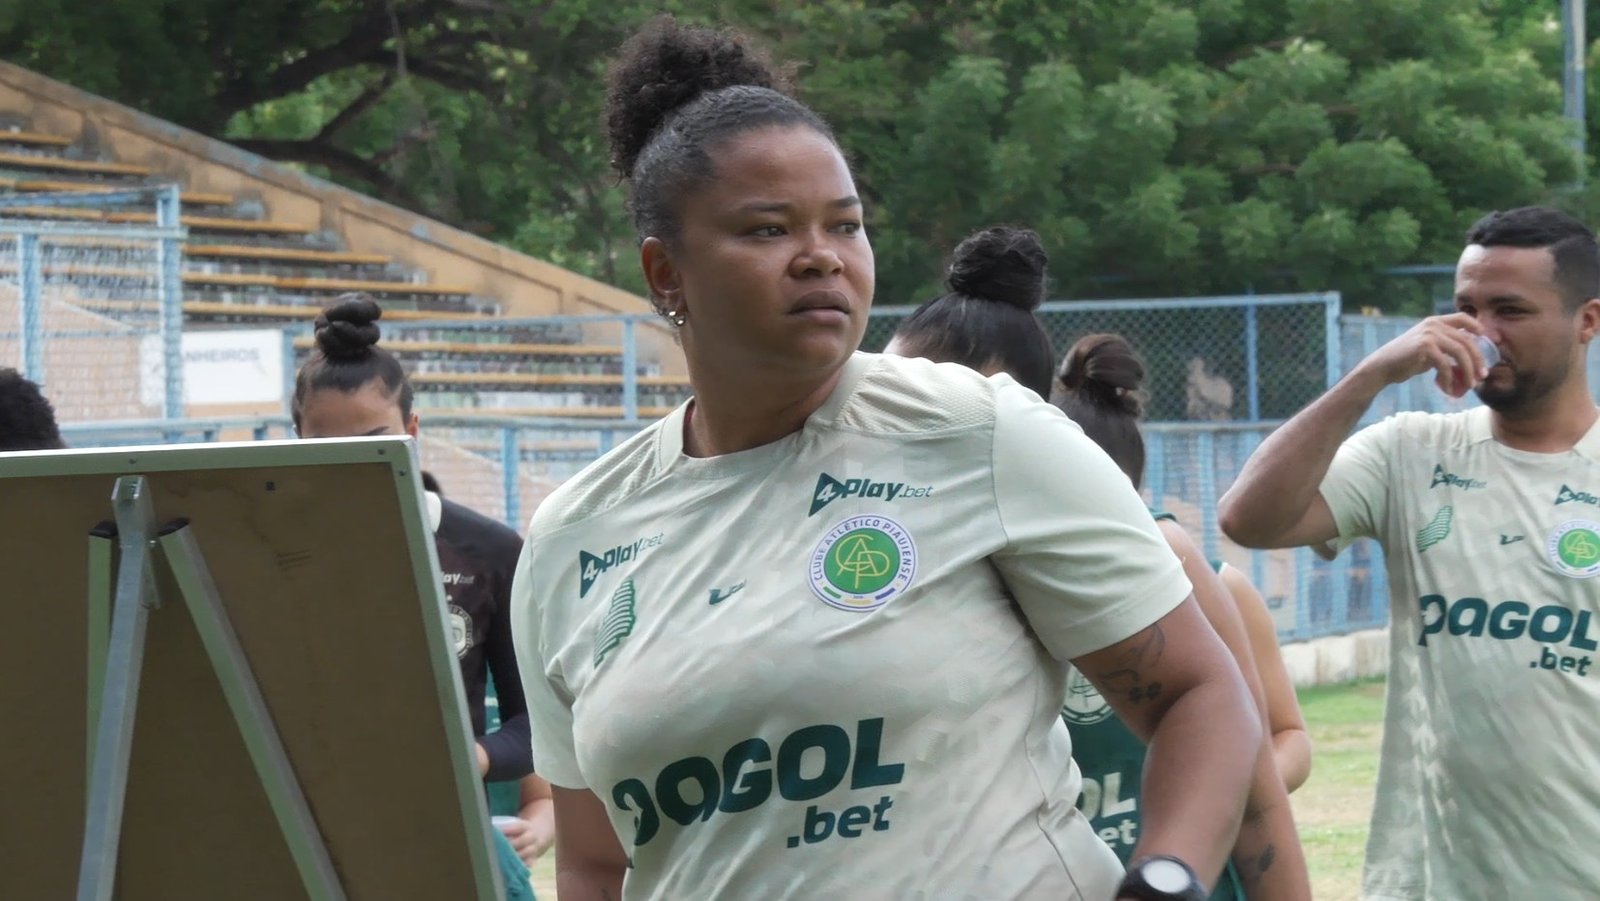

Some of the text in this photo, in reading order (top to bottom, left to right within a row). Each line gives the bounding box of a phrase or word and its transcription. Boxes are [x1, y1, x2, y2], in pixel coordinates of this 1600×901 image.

[183, 347, 260, 362] NHEIROS
[811, 476, 934, 506] 4Play.bet
[812, 548, 825, 581] CLUBE
[883, 522, 912, 582] PIAUIENSE
[1530, 646, 1591, 676] .bet
[787, 796, 893, 849] .bet
